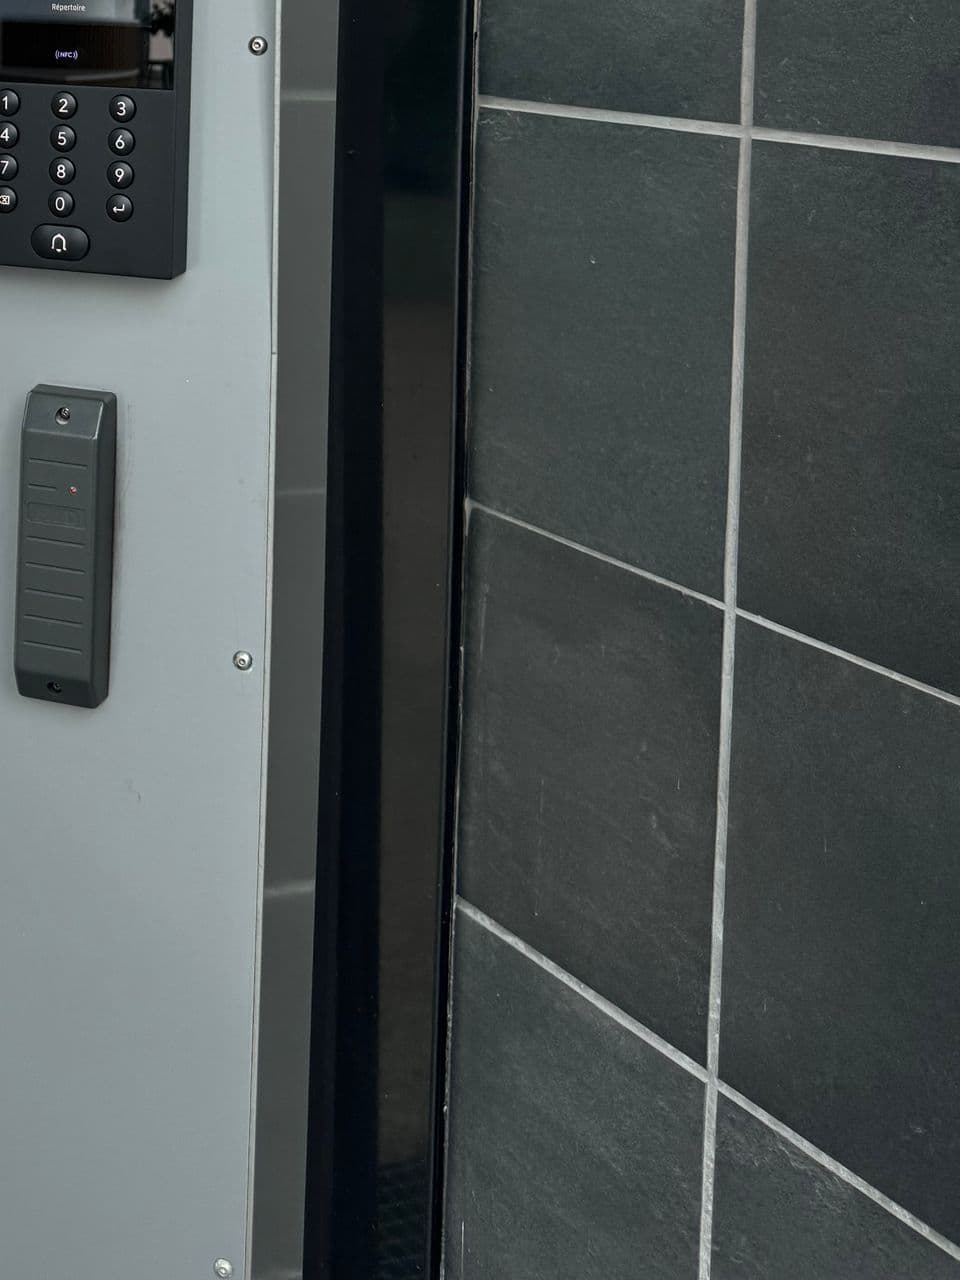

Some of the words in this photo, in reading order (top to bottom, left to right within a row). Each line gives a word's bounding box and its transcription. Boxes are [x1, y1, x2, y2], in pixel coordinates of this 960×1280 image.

[51, 2, 87, 13] Répertoire
[2, 96, 8, 110] 1
[58, 98, 69, 113] 2
[116, 101, 126, 116] 3
[0, 127, 10, 142] 4
[57, 131, 67, 146] 5
[115, 134, 125, 149] 6
[0, 160, 9, 175] 7
[56, 164, 66, 179] 8
[114, 168, 124, 183] 9
[55, 197, 65, 211] 0
